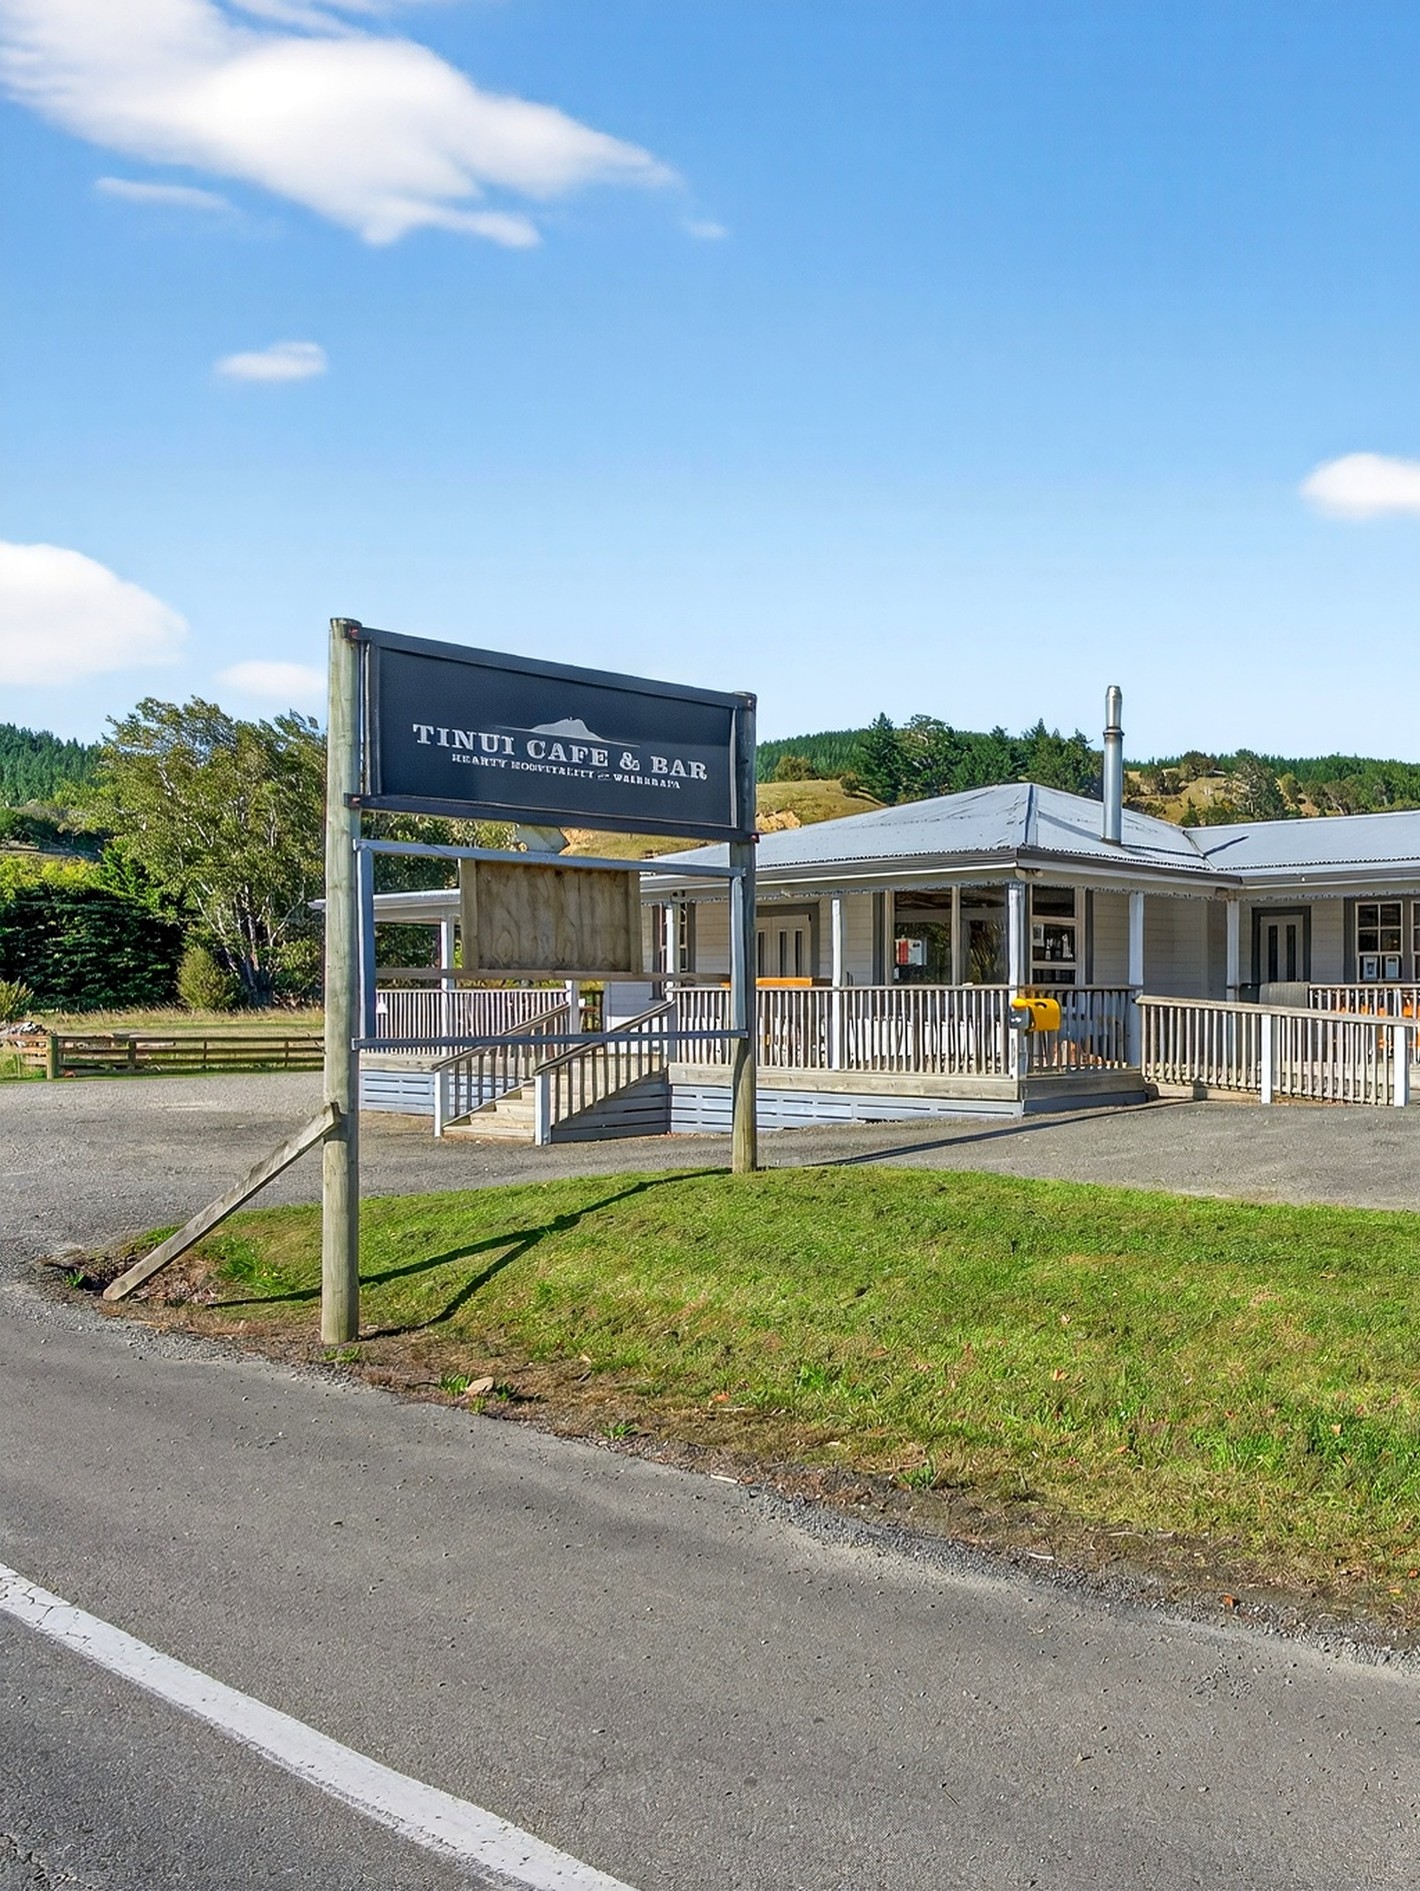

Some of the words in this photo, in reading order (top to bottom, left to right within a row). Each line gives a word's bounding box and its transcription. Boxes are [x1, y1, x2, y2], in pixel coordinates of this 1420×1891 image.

[412, 723, 516, 756] TINUI
[526, 739, 609, 767] CAFE
[619, 751, 641, 771] &
[650, 755, 708, 781] BAR
